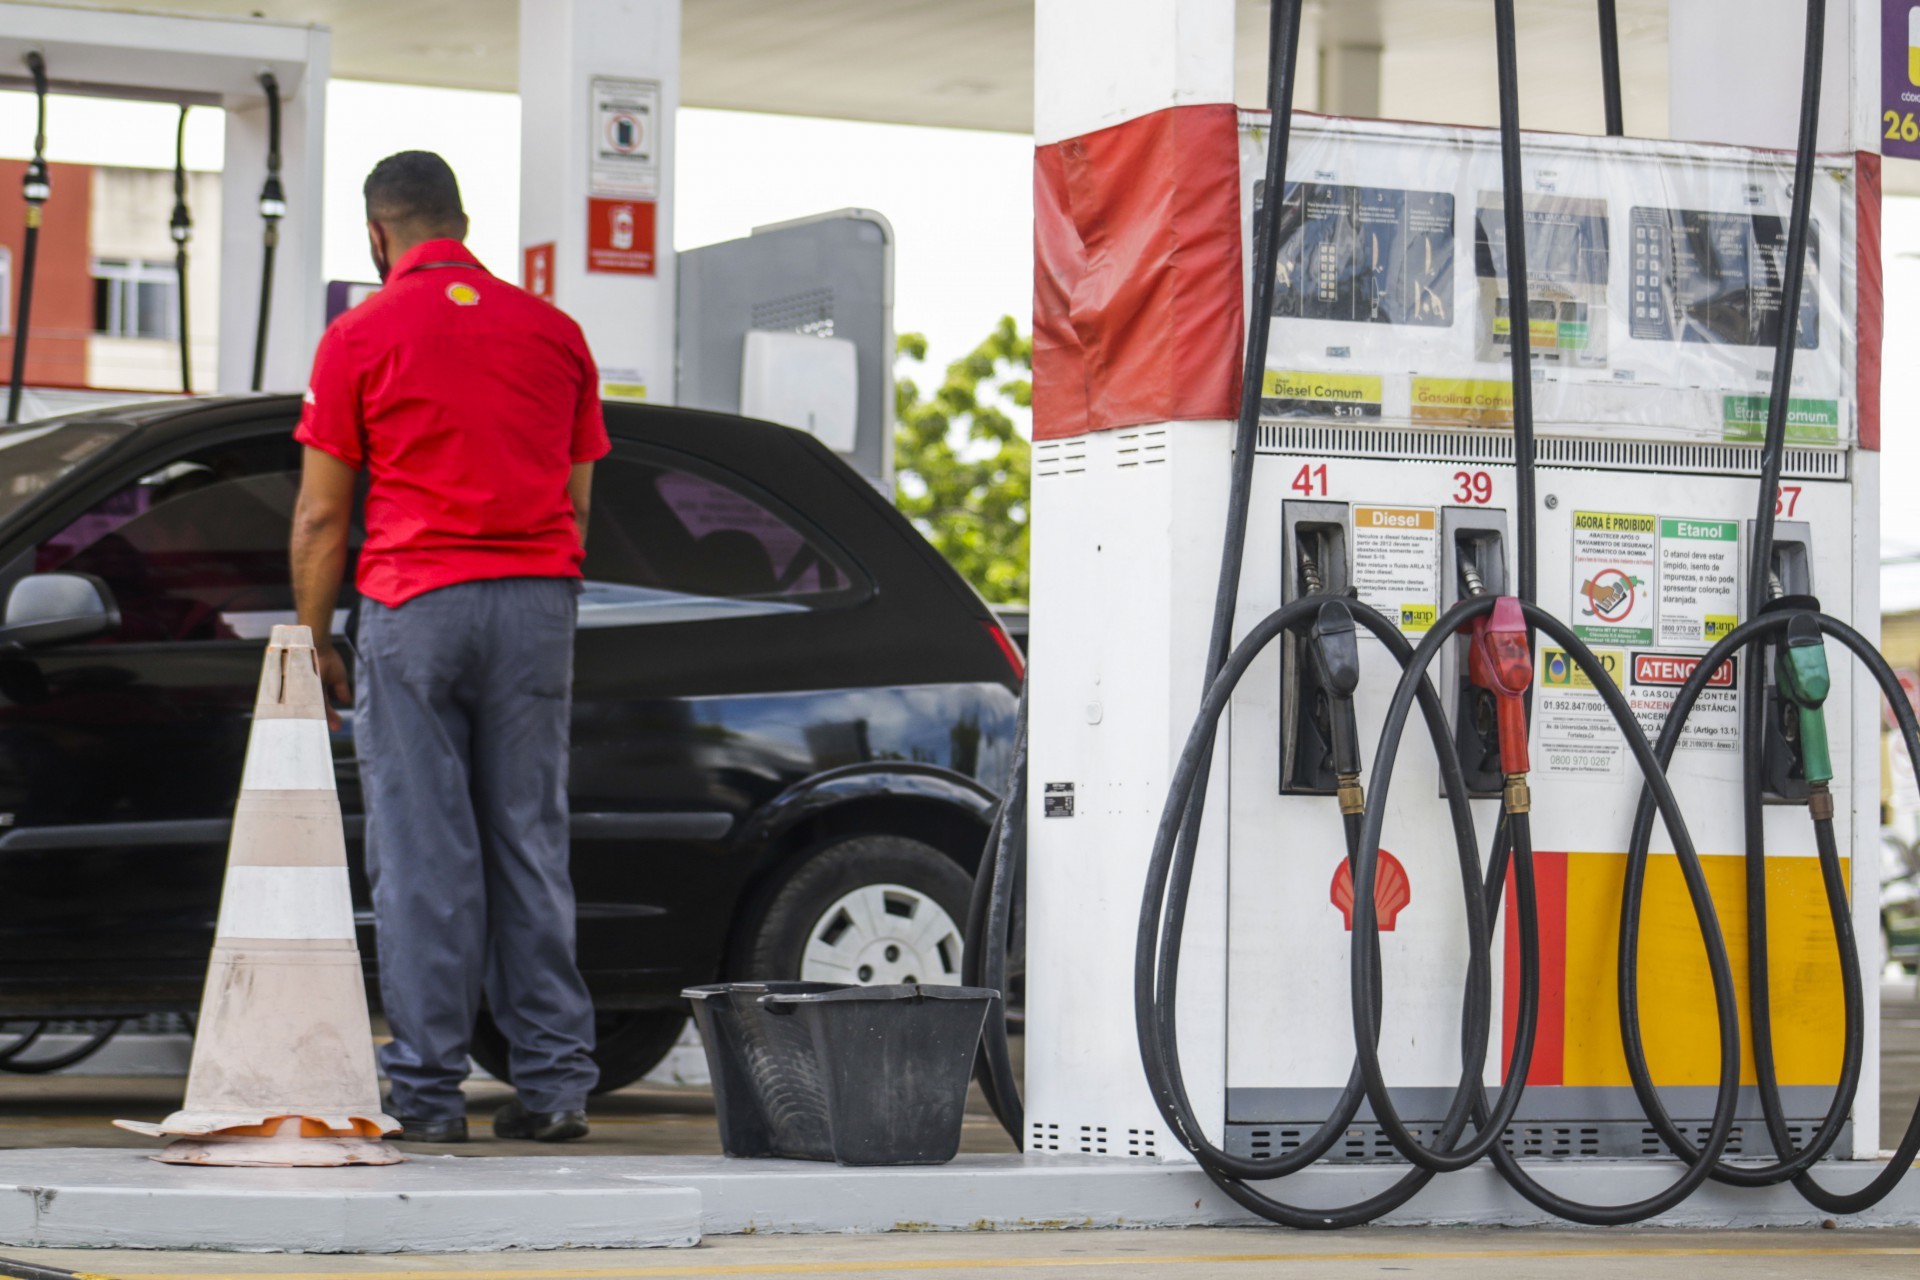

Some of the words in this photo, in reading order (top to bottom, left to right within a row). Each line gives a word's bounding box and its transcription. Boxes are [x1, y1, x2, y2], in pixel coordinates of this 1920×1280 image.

[1883, 110, 1920, 143] 26
[1274, 384, 1311, 397] Diesel
[1314, 386, 1363, 399] Comum
[1418, 391, 1472, 404] Gasolina
[1475, 395, 1513, 406] Comu
[1334, 405, 1362, 417] S-10
[1788, 411, 1828, 422] omum
[1292, 464, 1327, 496] 41
[1452, 471, 1492, 504] 39
[1372, 511, 1420, 527] Diesel
[1575, 515, 1603, 529] AGORA
[1606, 514, 1611, 530] É
[1613, 518, 1654, 532] PROIBIDO!
[1677, 522, 1722, 538] Etanol
[1663, 549, 1669, 558] O
[1670, 550, 1690, 559] etanol
[1692, 551, 1707, 560] deve
[1708, 553, 1725, 561] estar
[1690, 562, 1710, 571] isento
[1711, 563, 1720, 571] de
[1663, 572, 1698, 583] impurezas,
[1718, 575, 1735, 585] pode
[1663, 585, 1697, 593] apresentar
[1698, 585, 1731, 596] coloração
[1662, 595, 1698, 606] alaranjada.
[1413, 611, 1433, 623] anp
[1661, 624, 1675, 632] 0800
[1715, 622, 1735, 634] anp
[1640, 660, 1728, 681] ATENO!
[1630, 689, 1636, 697] A
[1642, 690, 1678, 699] GASOLI
[1698, 691, 1737, 701] CONTÉM
[1543, 700, 1610, 711] 01.952.847/0001-
[1691, 704, 1737, 713] BSTÂNCIA
[1693, 726, 1718, 736] (Artigo
[1720, 727, 1738, 736] 13.1).
[1716, 741, 1731, 749] Anexo
[1550, 755, 1570, 765] 0800
[1573, 755, 1588, 766] 970
[1591, 757, 1611, 767] 0267
